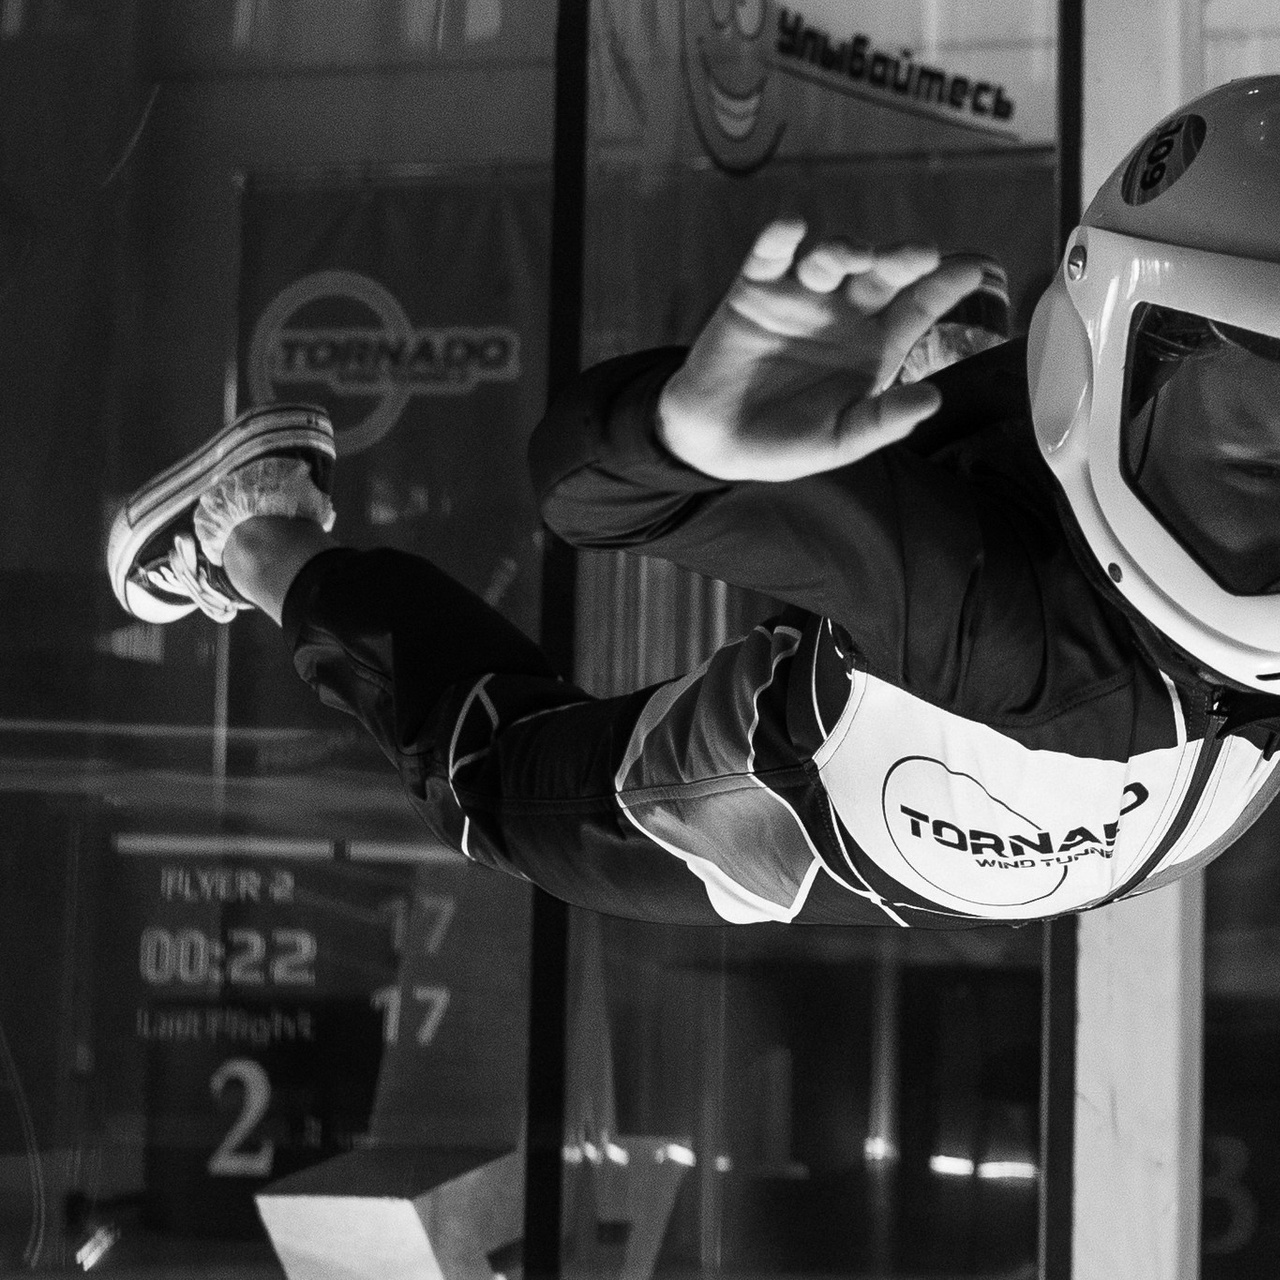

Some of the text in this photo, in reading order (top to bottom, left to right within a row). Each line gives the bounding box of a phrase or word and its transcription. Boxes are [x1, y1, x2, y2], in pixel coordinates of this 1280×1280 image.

[776, 7, 1015, 122] Улыбайтесь
[281, 336, 512, 372] TORNADO
[974, 846, 1115, 871] WIND TUNNE
[138, 925, 318, 987] 00:22
[371, 983, 452, 1047] 17
[207, 1056, 276, 1179] 2
